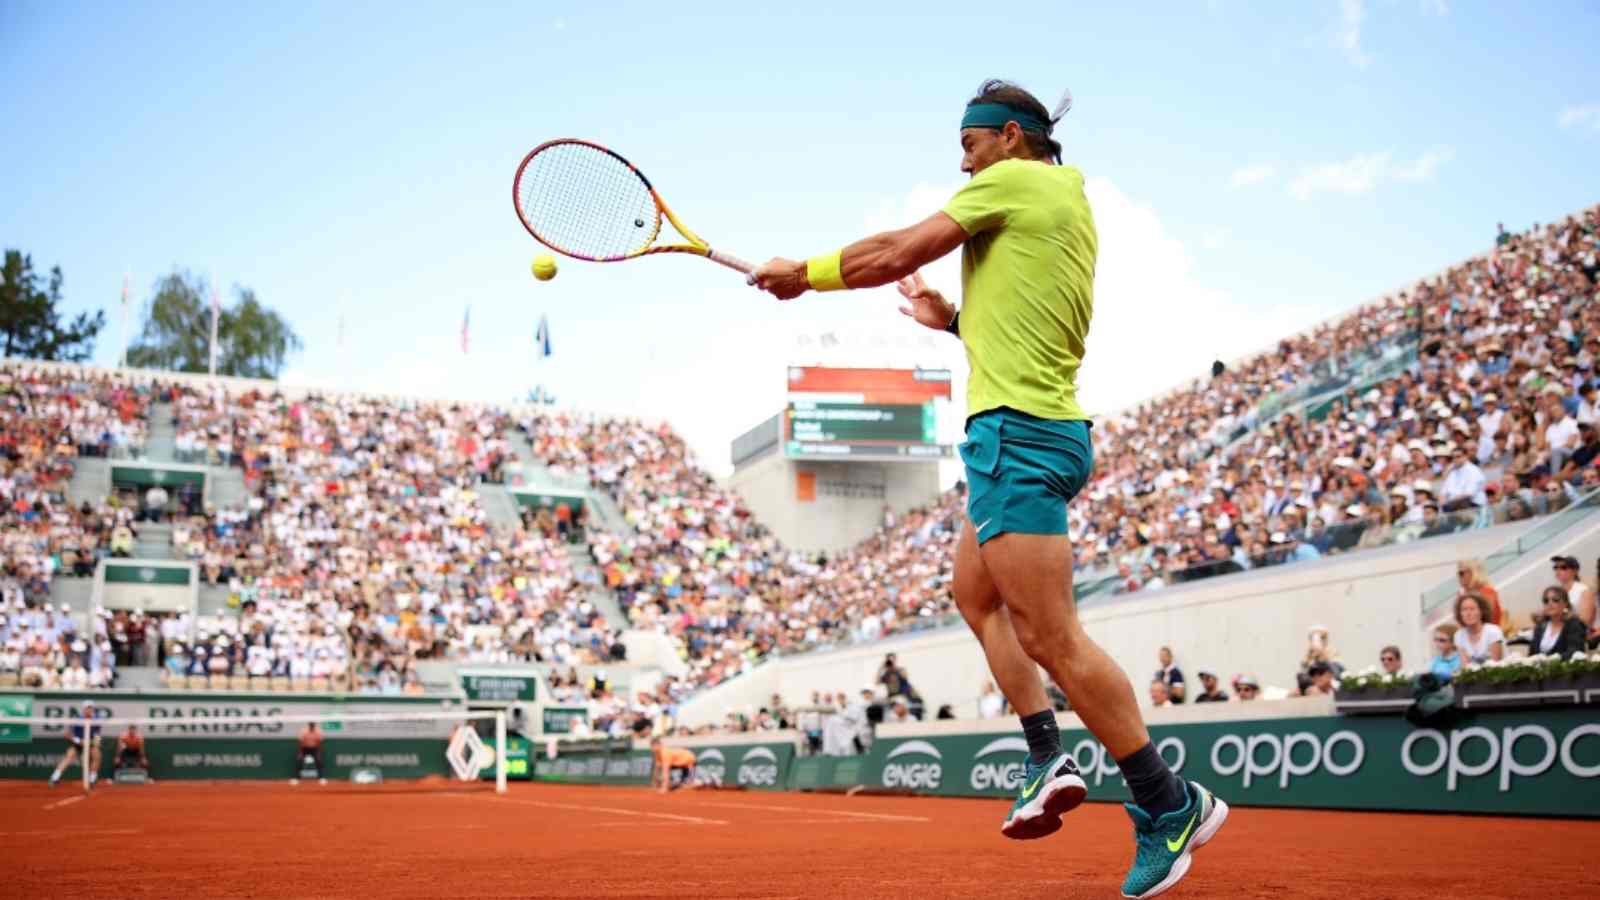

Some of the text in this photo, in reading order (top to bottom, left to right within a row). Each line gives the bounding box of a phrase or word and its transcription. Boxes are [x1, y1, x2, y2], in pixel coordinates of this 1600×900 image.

[1073, 736, 1186, 787] opo
[1211, 730, 1365, 788] oppo
[1401, 724, 1600, 791] oppo
